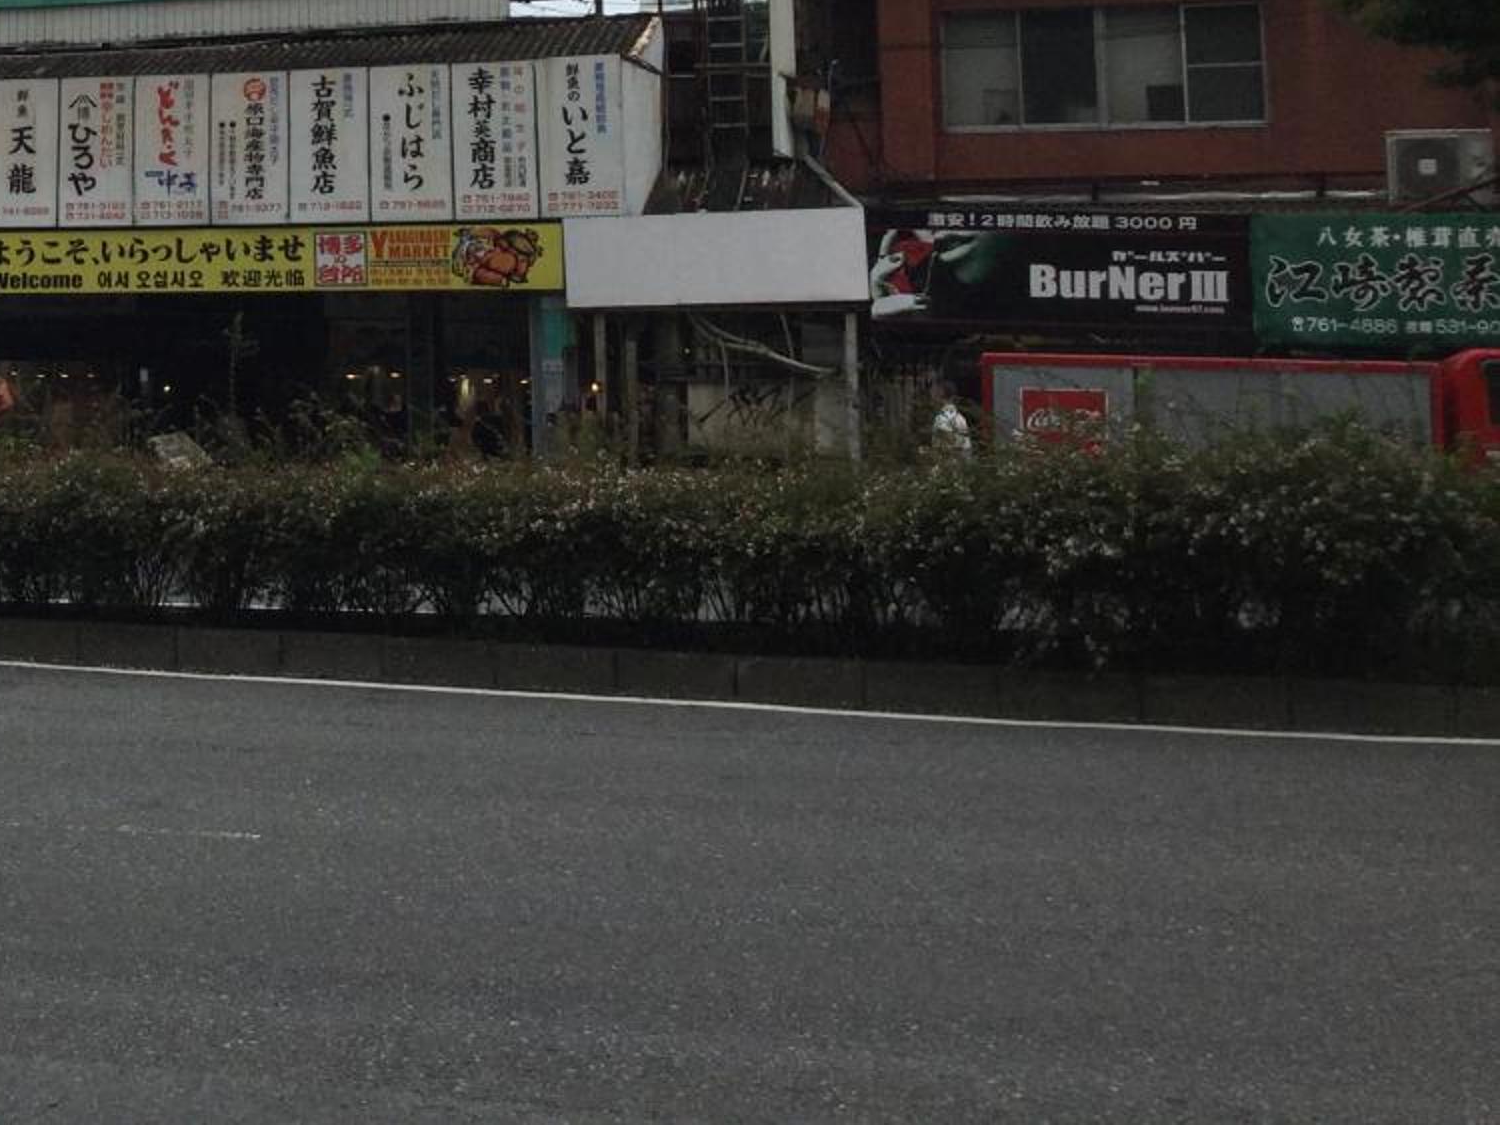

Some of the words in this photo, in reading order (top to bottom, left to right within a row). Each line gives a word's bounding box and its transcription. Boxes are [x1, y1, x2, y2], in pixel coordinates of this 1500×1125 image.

[6, 126, 37, 194] 天龍
[68, 124, 97, 196] ひろや
[310, 75, 338, 195] 古賀鮮魚店
[398, 72, 425, 191] ふじはら
[98, 270, 129, 288] 어서
